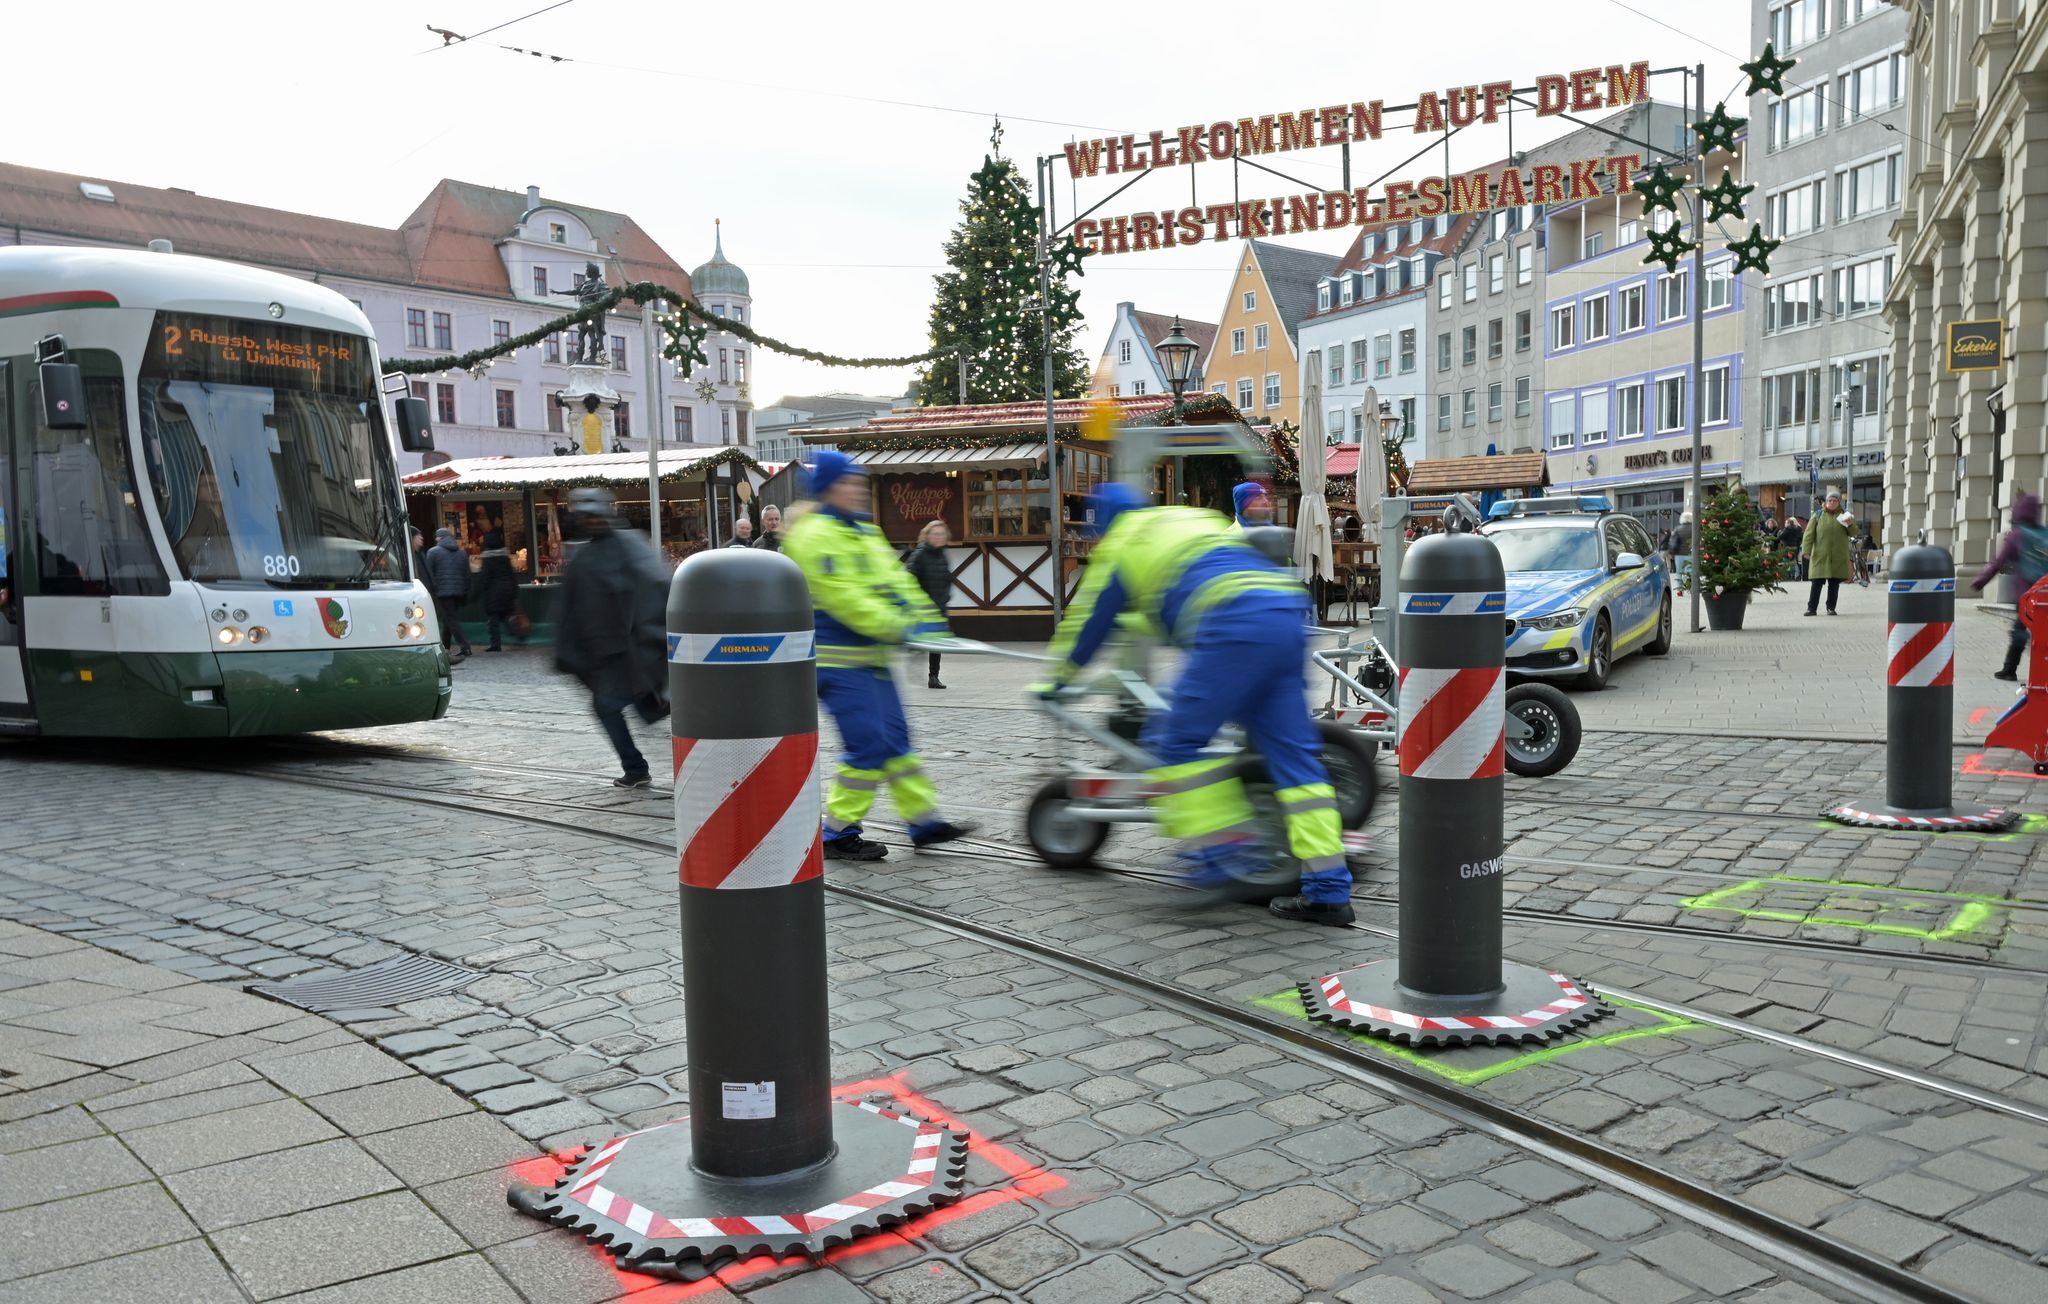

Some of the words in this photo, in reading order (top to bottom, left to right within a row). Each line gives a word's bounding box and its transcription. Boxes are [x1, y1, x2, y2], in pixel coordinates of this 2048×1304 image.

[1064, 99, 1384, 179] WILLKOMMEN
[1414, 81, 1513, 134] AUF
[1535, 61, 1650, 118] DEM
[1073, 153, 1642, 256] CHRISTKINDLESMARKT
[164, 325, 183, 355] 2
[190, 328, 260, 350] Augsb.
[266, 338, 312, 356] West
[317, 345, 350, 361] P+R
[246, 351, 322, 370] Uniklinik
[1624, 449, 1667, 470] HENRY'S
[891, 482, 952, 504] Knusper
[900, 500, 943, 521] Häusl
[263, 555, 300, 577] 880
